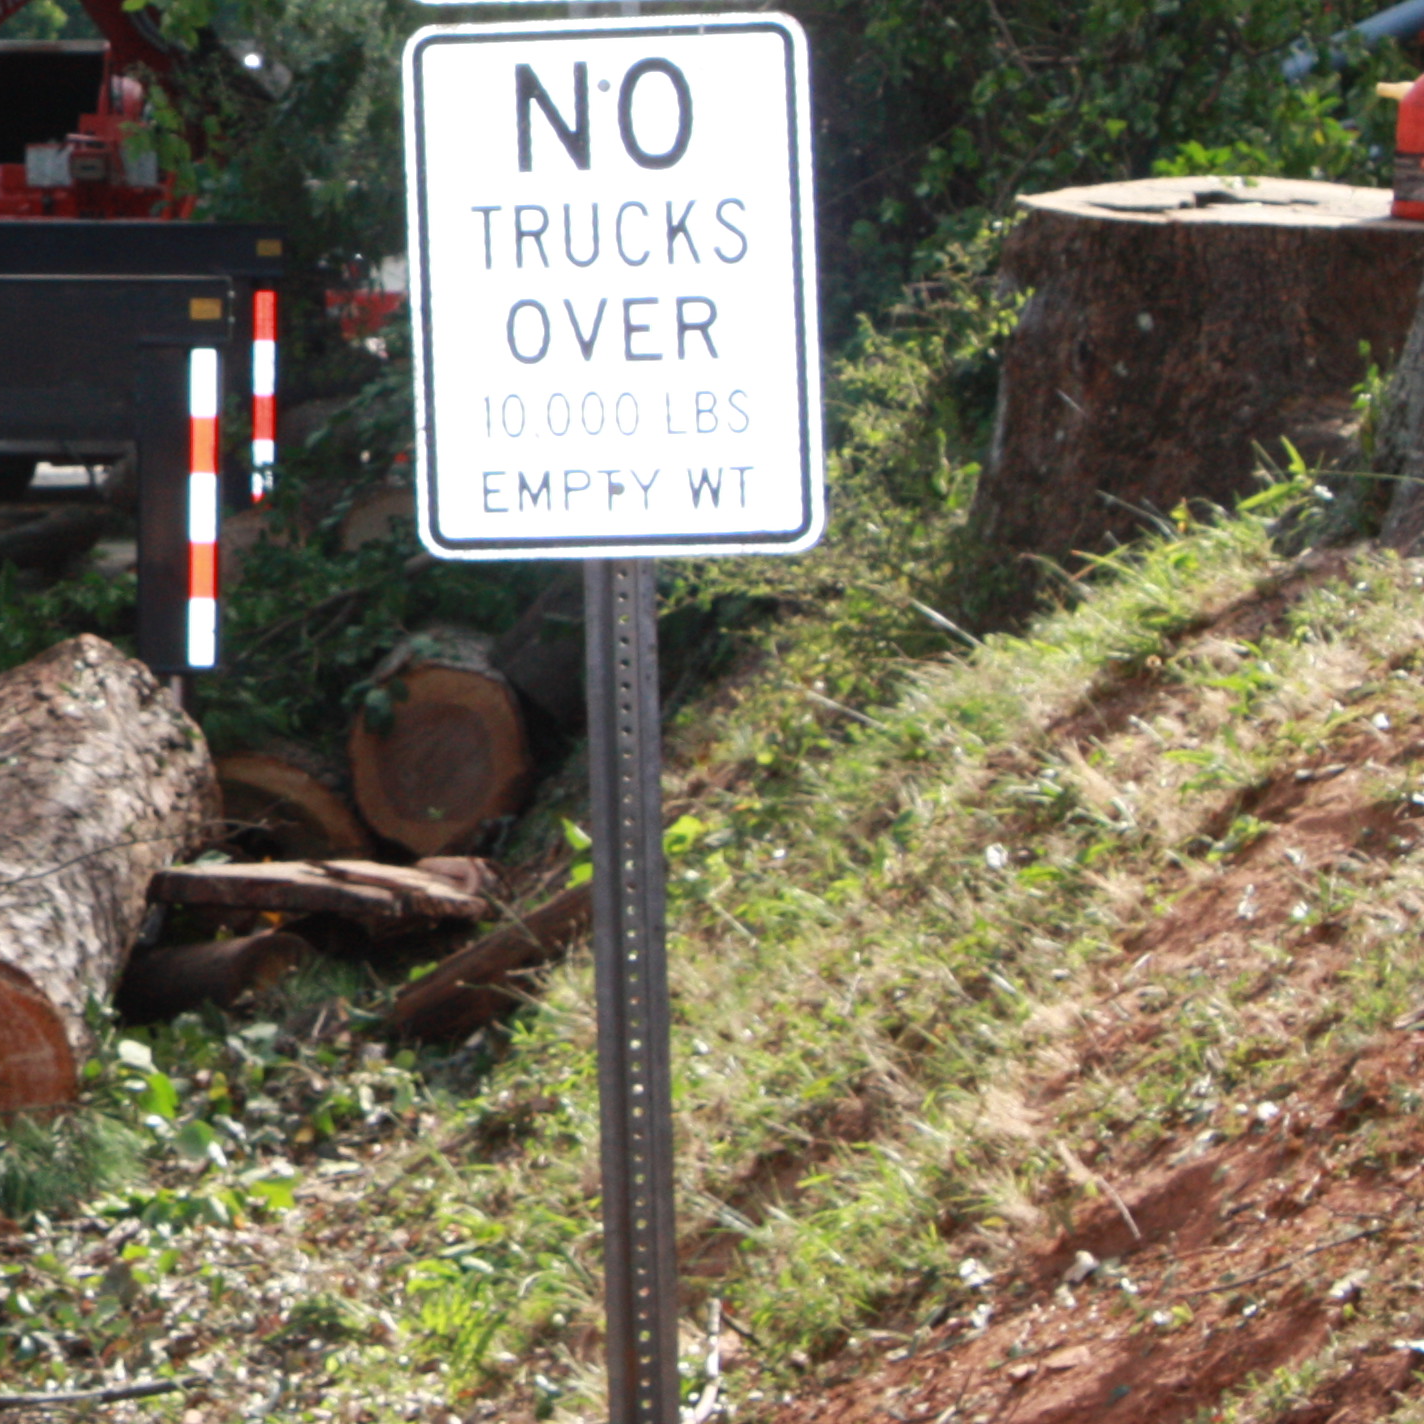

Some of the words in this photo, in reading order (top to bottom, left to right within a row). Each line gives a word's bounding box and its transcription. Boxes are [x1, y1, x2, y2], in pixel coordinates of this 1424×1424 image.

[514, 57, 694, 172] NO
[471, 198, 748, 270] TRUCKS
[506, 296, 719, 364] OVER
[665, 389, 750, 435] LBS
[482, 469, 660, 514] EMPTY
[687, 466, 754, 509] WT
